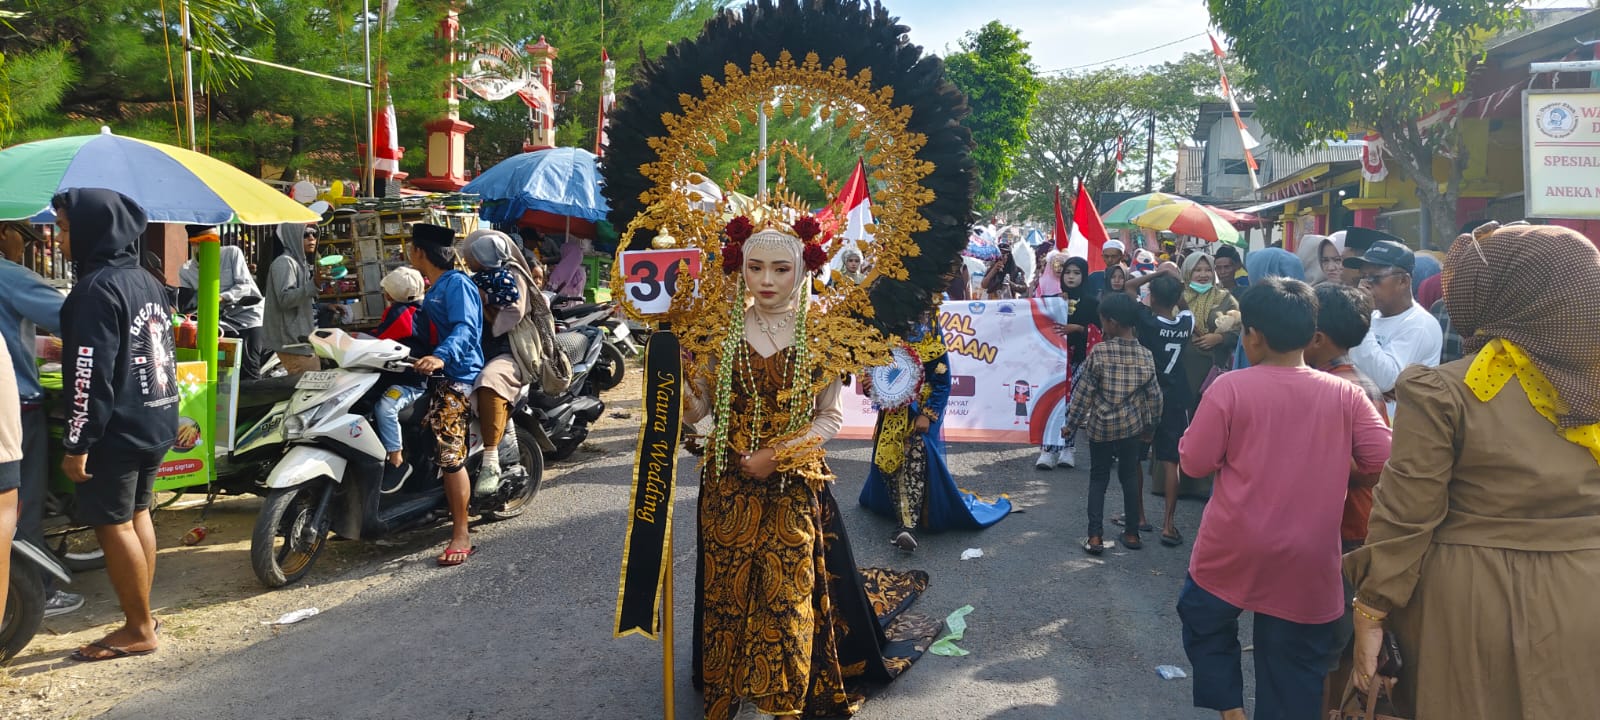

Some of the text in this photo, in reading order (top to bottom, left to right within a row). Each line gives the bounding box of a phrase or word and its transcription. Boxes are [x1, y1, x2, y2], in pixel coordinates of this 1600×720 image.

[1544, 155, 1600, 167] SPESIAL
[1545, 186, 1592, 197] ANEKA
[631, 258, 695, 301] 36
[1160, 329, 1189, 338] RIYAN
[1164, 343, 1181, 374] 7
[636, 371, 675, 524] Naura Wedding
